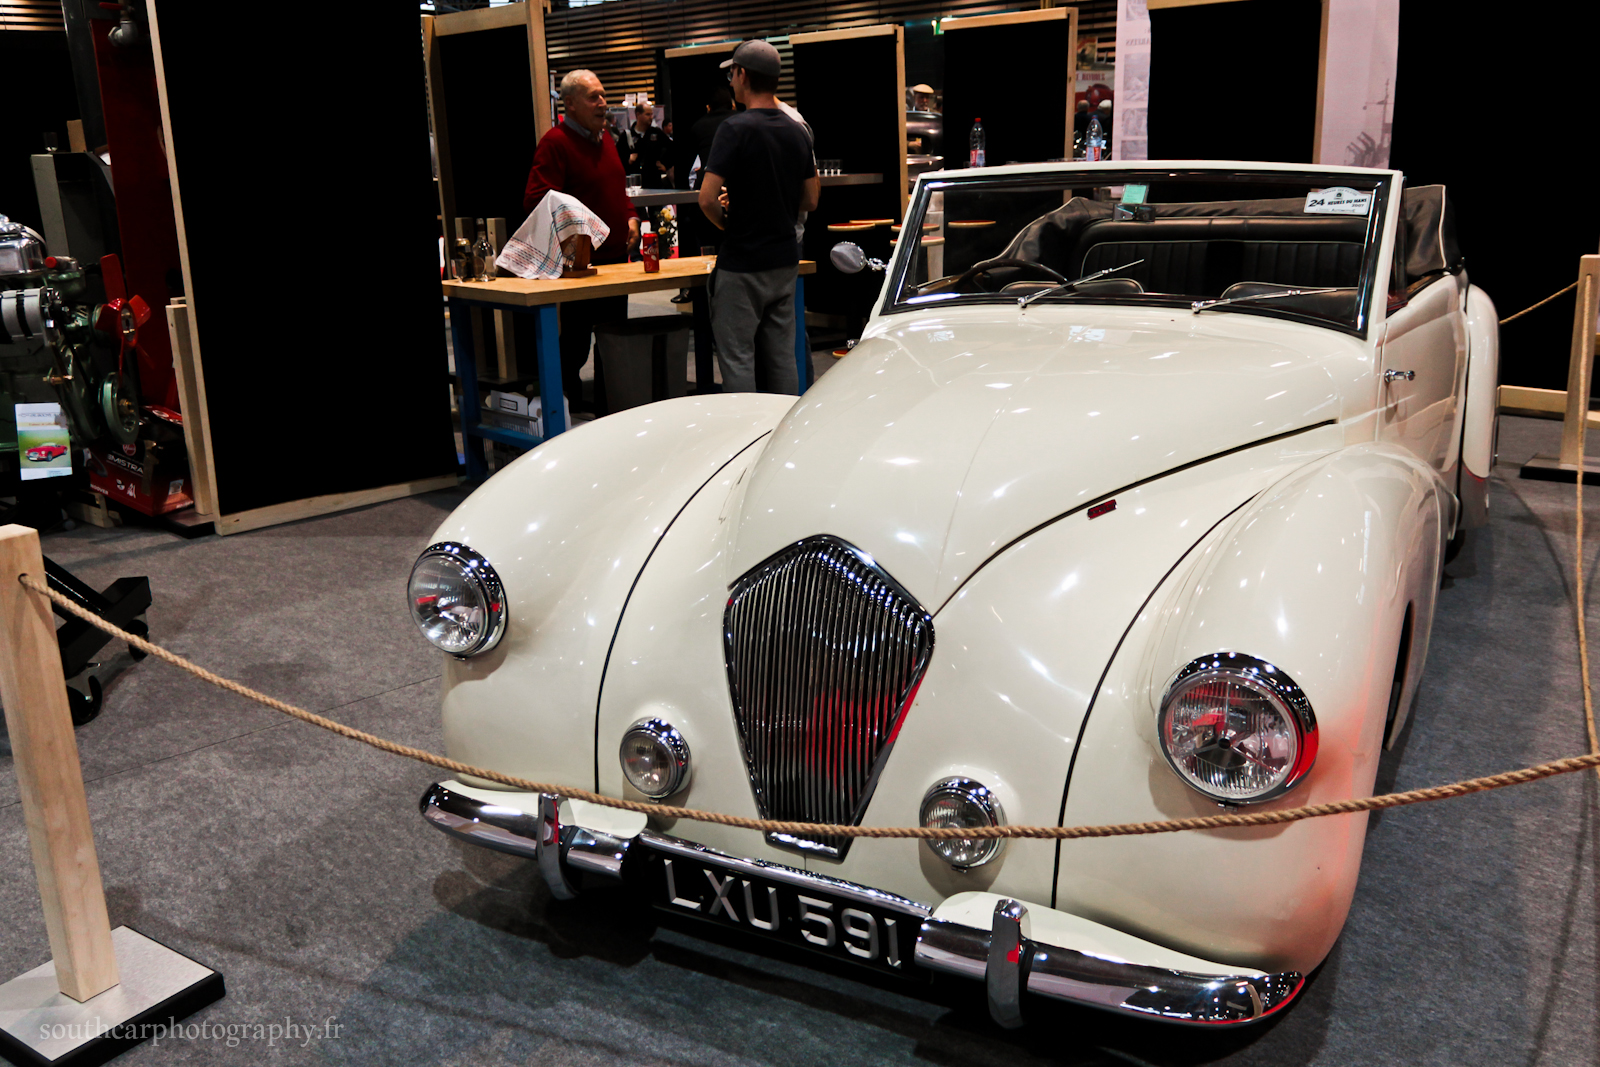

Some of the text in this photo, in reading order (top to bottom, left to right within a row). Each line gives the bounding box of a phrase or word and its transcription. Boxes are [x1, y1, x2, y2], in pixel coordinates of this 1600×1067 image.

[1308, 199, 1325, 208] 24
[664, 859, 901, 968] LXU 591
